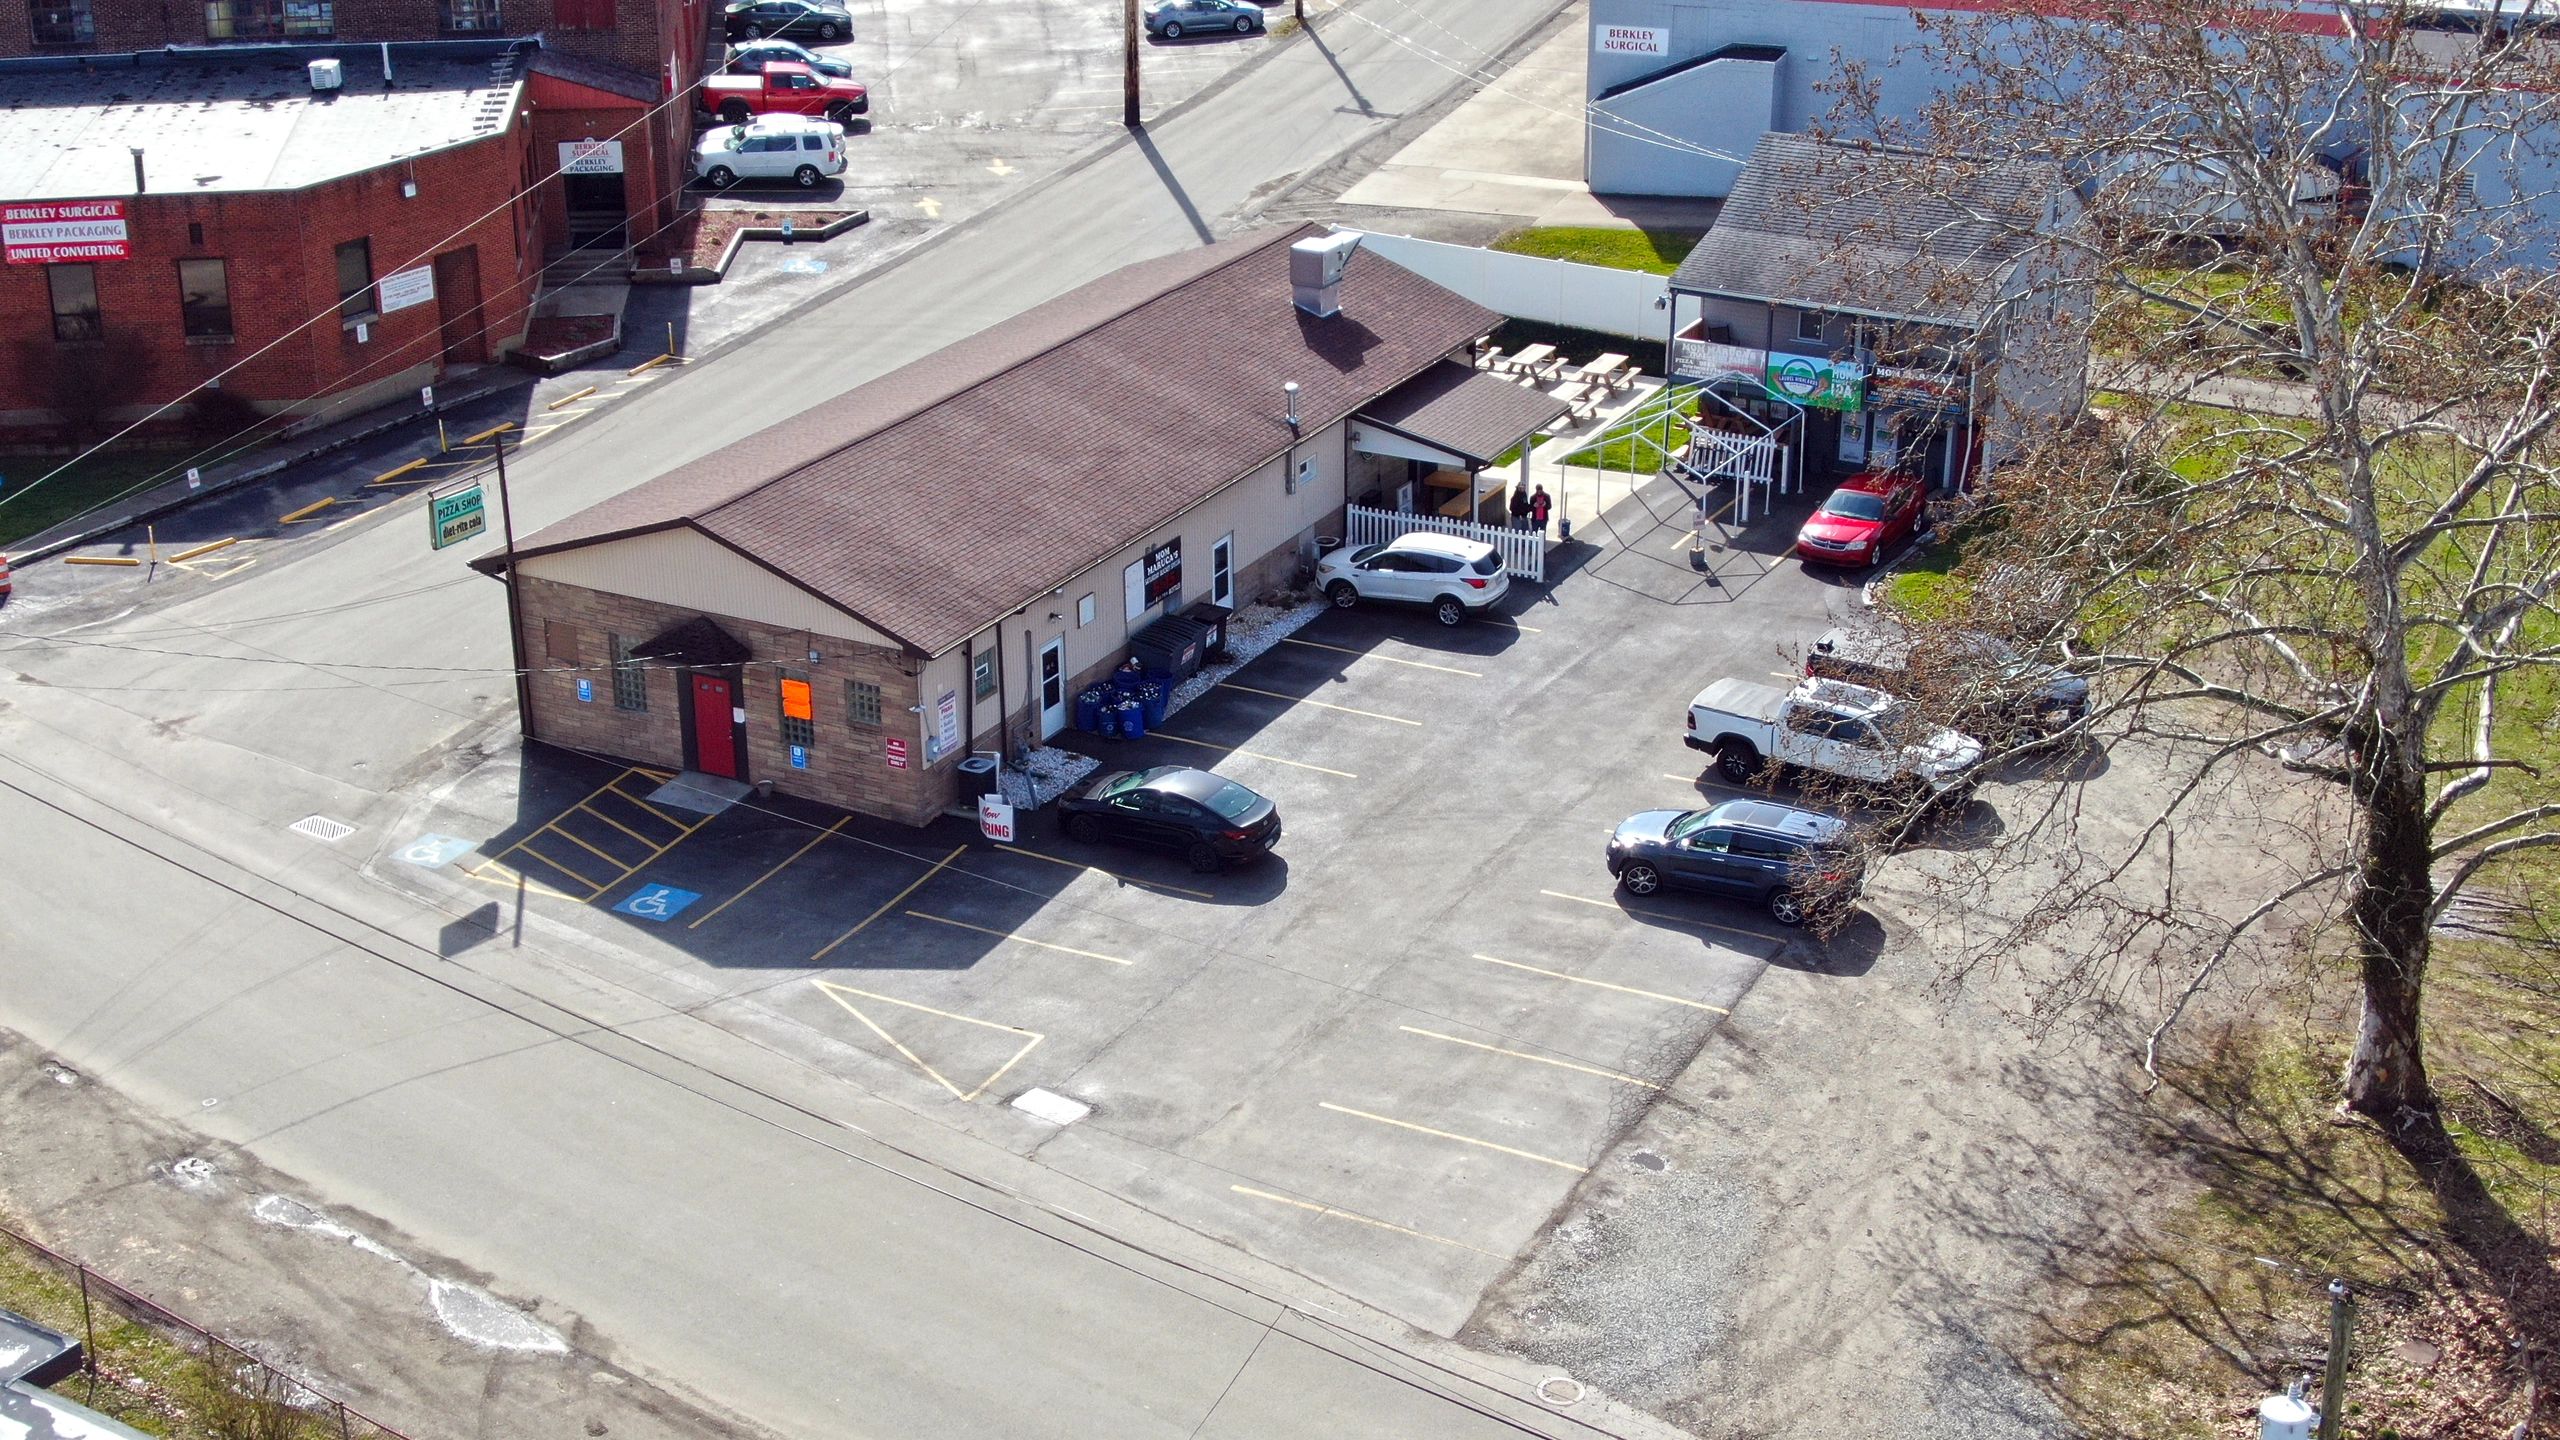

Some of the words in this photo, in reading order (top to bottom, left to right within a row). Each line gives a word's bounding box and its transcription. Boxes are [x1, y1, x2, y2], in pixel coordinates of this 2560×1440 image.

[1609, 28, 1655, 40] BERKLEY
[1604, 40, 1659, 53] SURGICAL
[571, 149, 609, 157] SURGICAL
[575, 158, 606, 166] BERKLEY
[569, 165, 614, 173] PACKAGING
[5, 207, 56, 220] BERKLEY
[59, 204, 119, 218] SURGICAL
[8, 227, 54, 240] BERKLEY
[56, 224, 122, 238] PACKAGING
[10, 247, 51, 259] UNITED
[53, 244, 125, 257] CONVERTING
[1682, 342, 1706, 353] MOM
[1876, 367, 1900, 377] MOM
[438, 503, 460, 519] PIZZA
[461, 495, 481, 511] SHOP
[442, 521, 468, 539] diet-rite
[469, 514, 482, 529] cola
[1155, 546, 1171, 561] MOM
[1146, 550, 1179, 576] MARUCA'S
[981, 806, 1001, 819] Now
[982, 818, 1010, 838] RING
